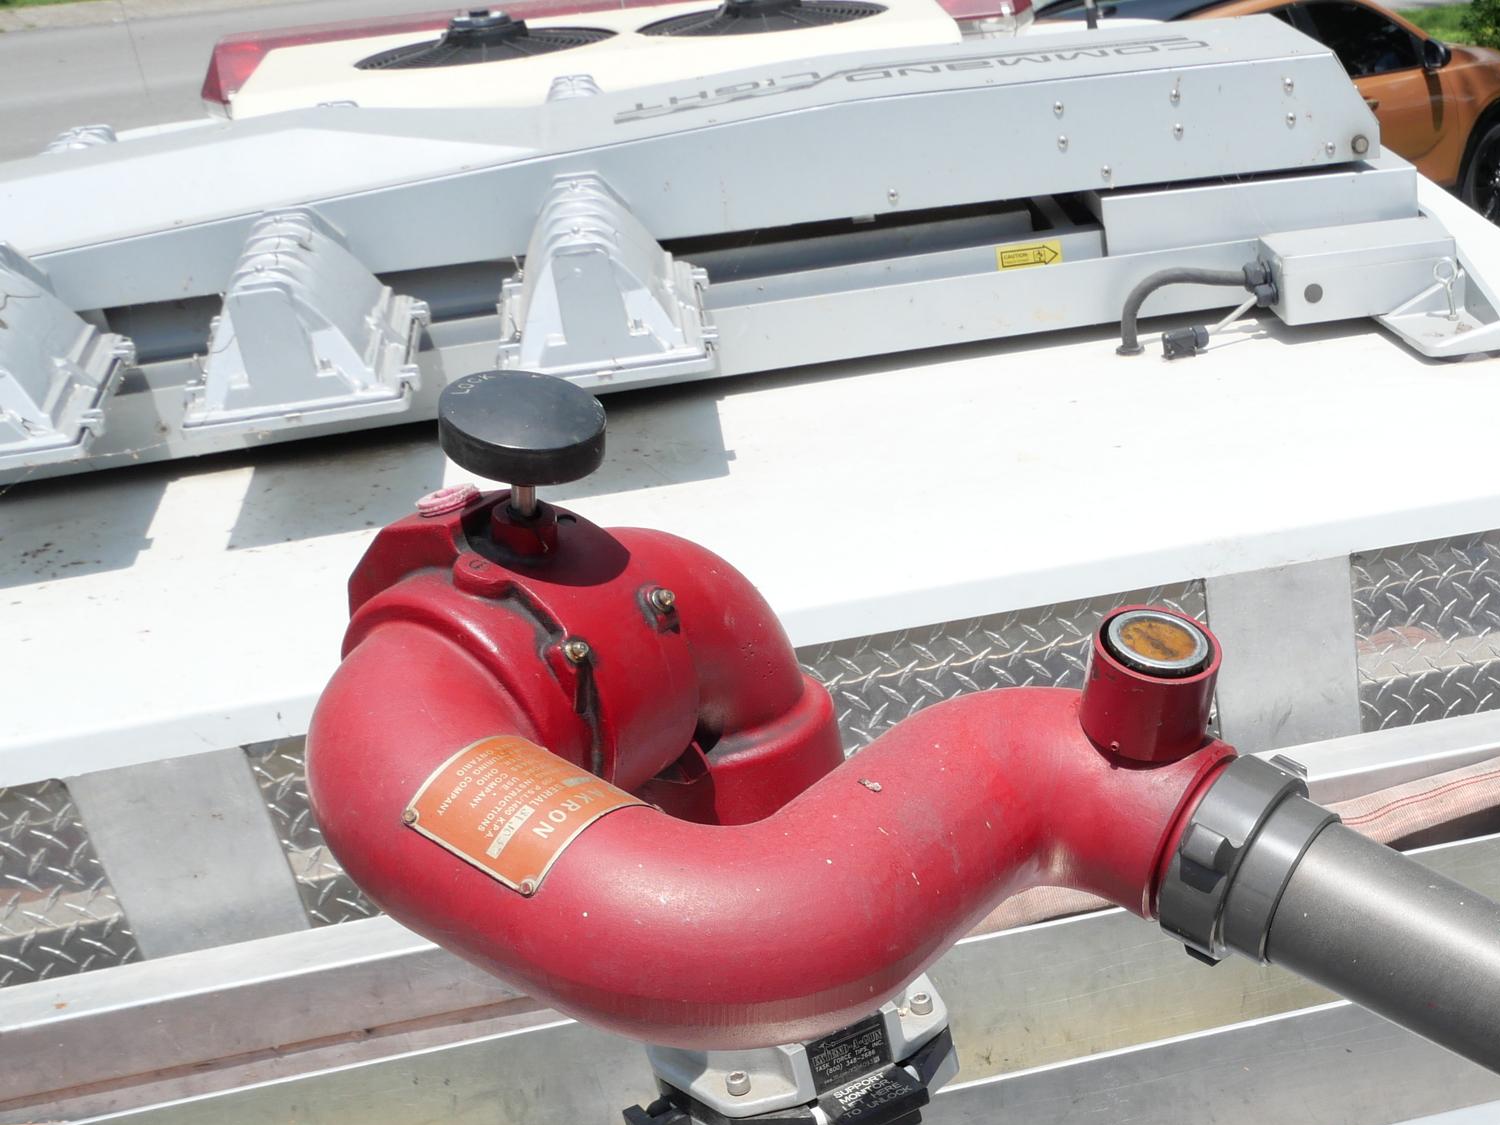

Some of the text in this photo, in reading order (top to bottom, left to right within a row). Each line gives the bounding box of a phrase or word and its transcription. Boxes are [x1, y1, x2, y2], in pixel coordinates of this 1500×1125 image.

[451, 373, 496, 395] LOCK
[471, 773, 508, 808] COMPANY
[476, 768, 499, 786] OHIO
[501, 777, 519, 791] USE
[437, 776, 472, 816] COMPANY
[477, 778, 534, 832] INSTRUCTIONS
[815, 1063, 833, 1073] TASK
[834, 1053, 852, 1065] FORCE
[834, 1072, 884, 1099] SUPPORT
[842, 1082, 901, 1111] LIFT HERE
[843, 1085, 912, 1119] TO UNLOCK
